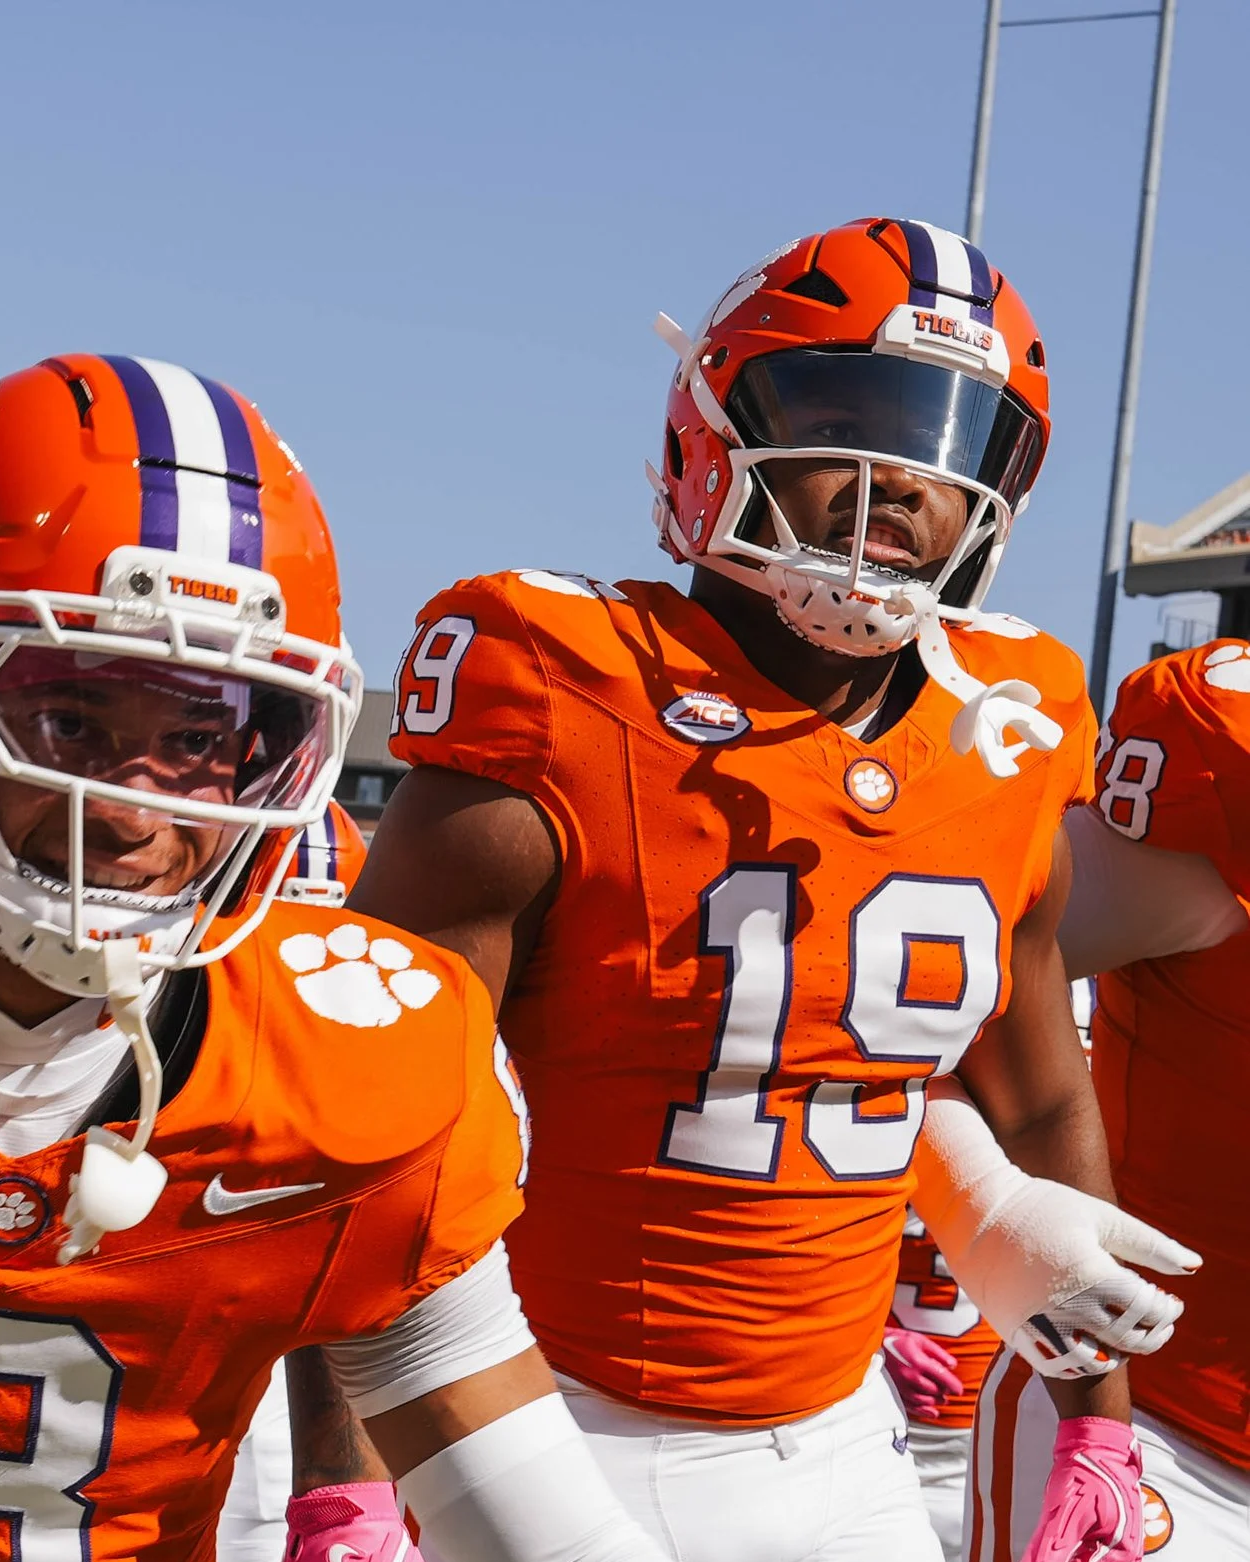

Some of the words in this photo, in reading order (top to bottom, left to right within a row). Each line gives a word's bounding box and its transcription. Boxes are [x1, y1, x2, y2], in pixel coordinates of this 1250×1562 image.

[912, 311, 993, 352] TIGERS
[168, 575, 239, 605] TIGERS
[673, 704, 739, 728] ACC
[656, 861, 1001, 1181] 19
